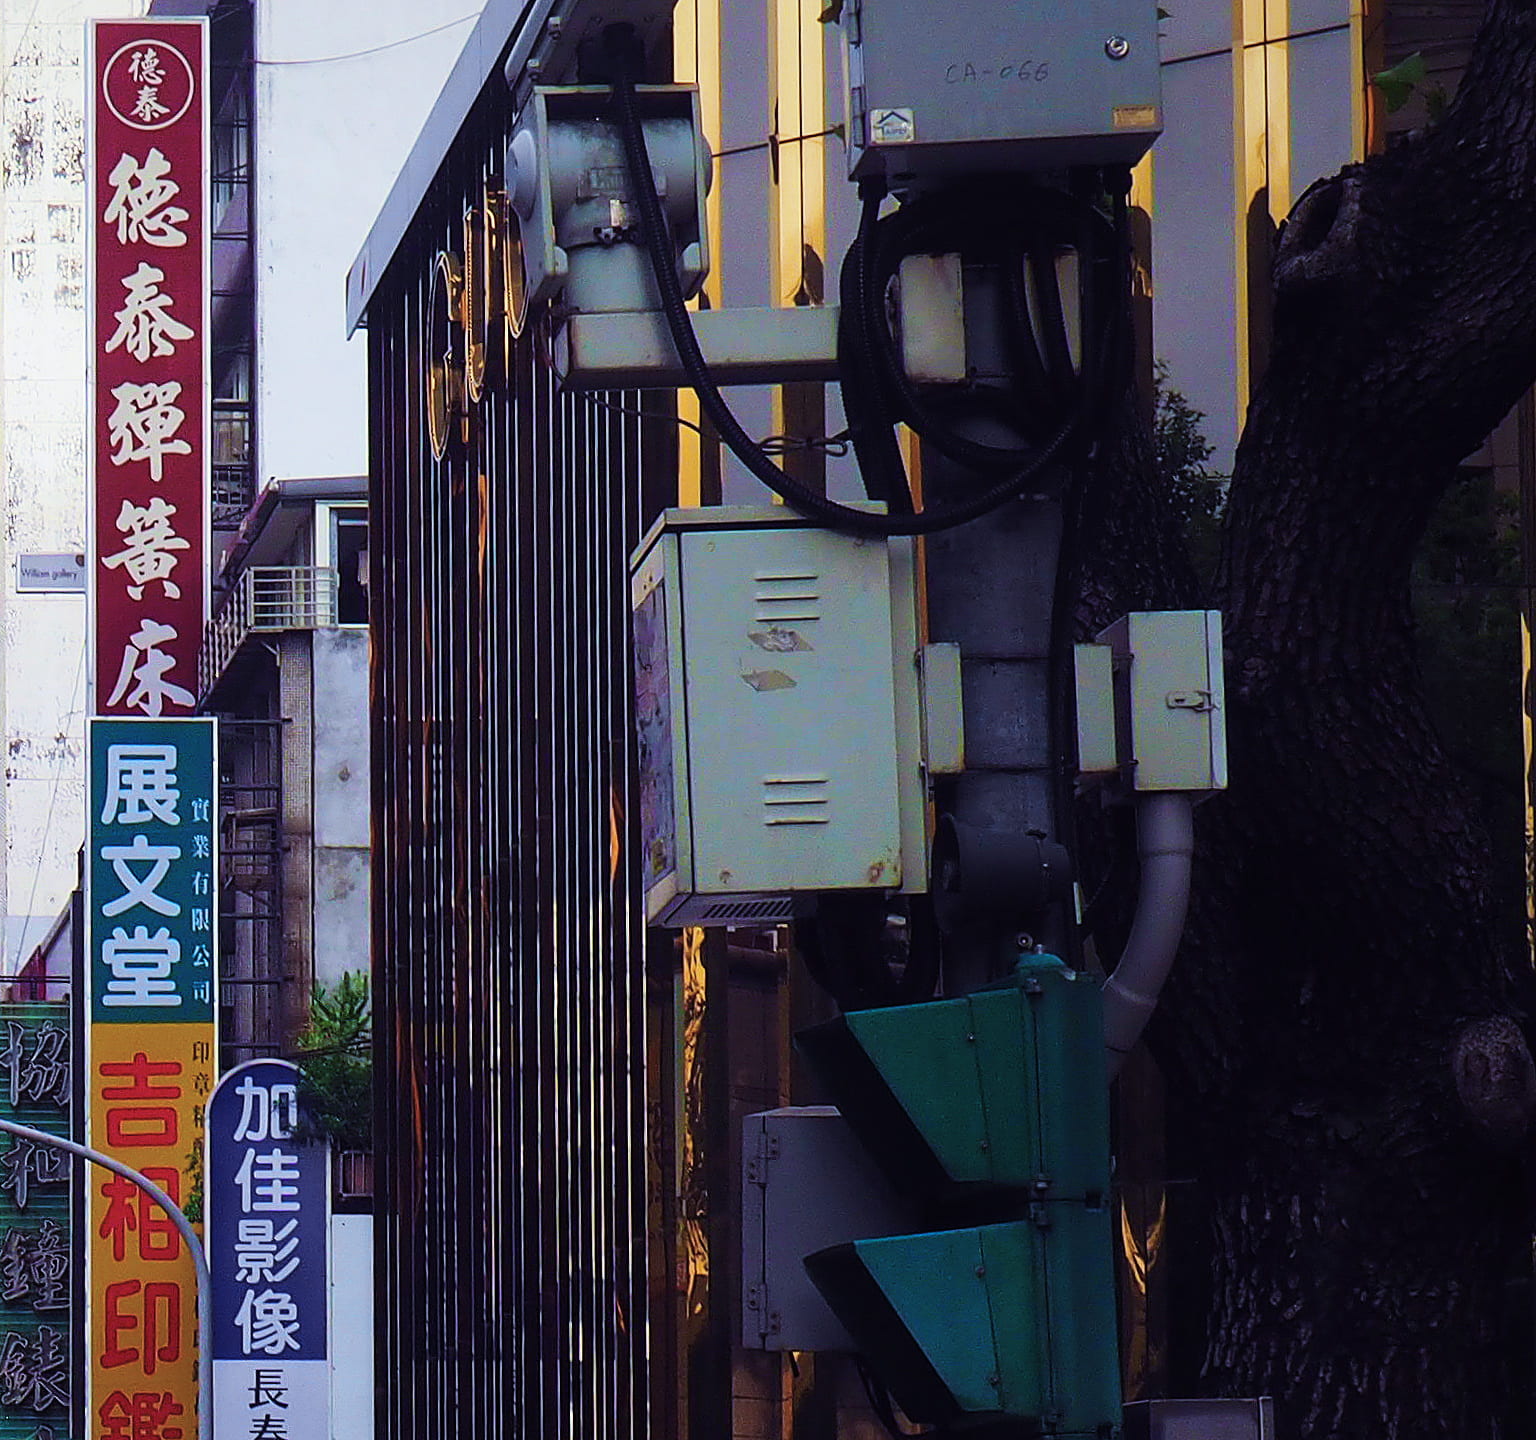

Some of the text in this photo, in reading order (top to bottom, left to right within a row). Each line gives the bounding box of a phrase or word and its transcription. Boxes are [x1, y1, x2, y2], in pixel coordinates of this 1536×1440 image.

[128, 48, 171, 122] 德泰
[101, 148, 196, 717] 德泰彈簧床
[100, 743, 182, 1009] 展文堂
[191, 797, 212, 1005] 實業有限公司
[233, 1075, 301, 1356] 加佳影像
